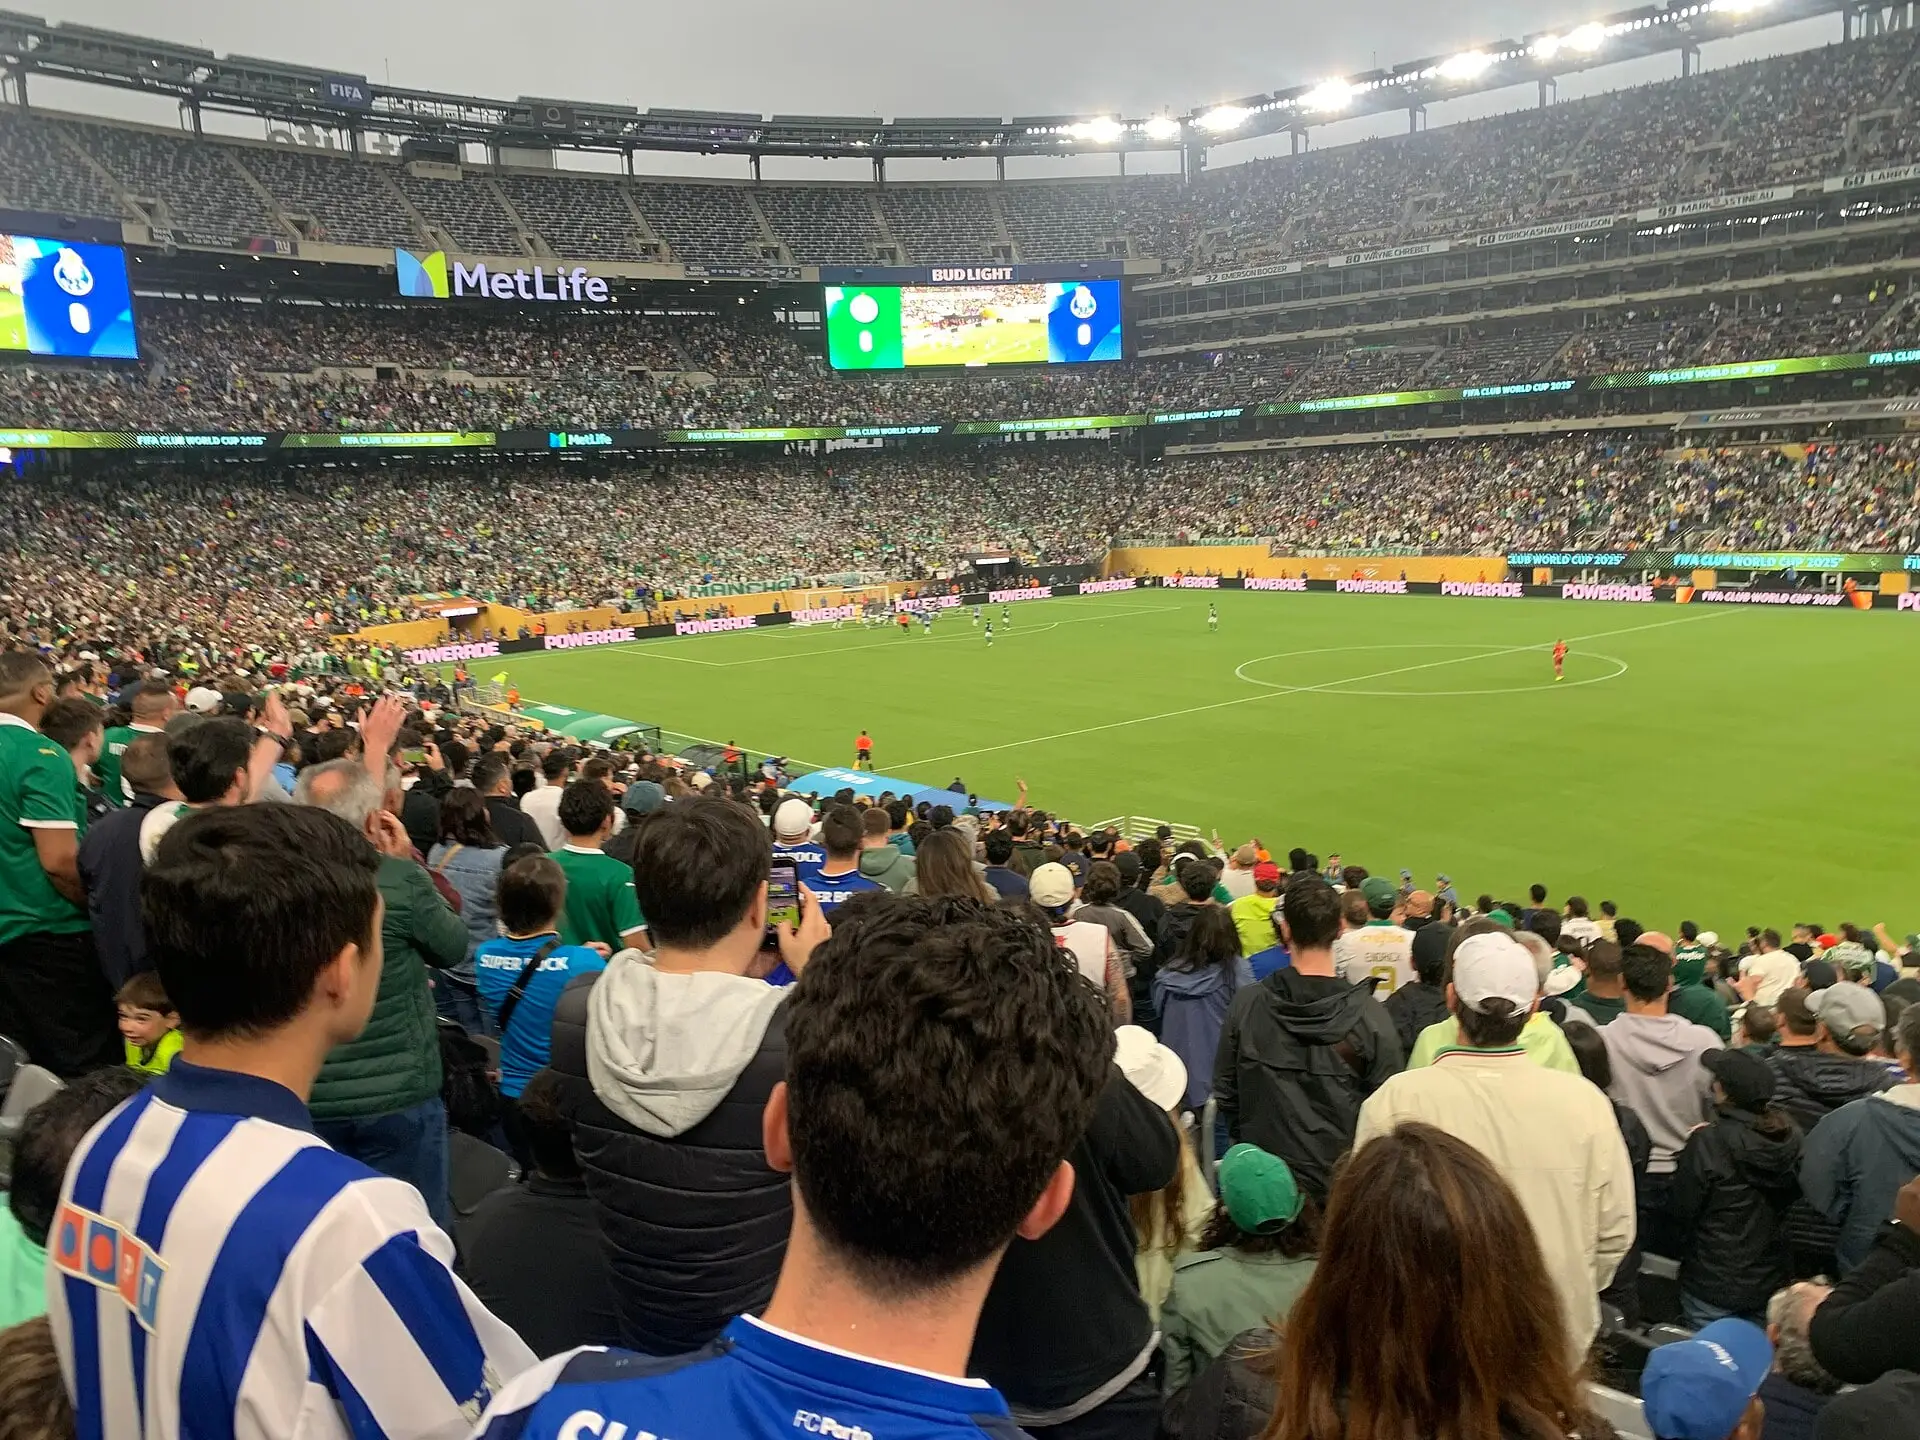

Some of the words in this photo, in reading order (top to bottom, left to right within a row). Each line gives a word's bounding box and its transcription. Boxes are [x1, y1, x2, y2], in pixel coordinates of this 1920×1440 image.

[330, 83, 362, 100] FIFA
[1479, 234, 1496, 246] 60
[1563, 217, 1611, 233] FERGUSON
[1345, 254, 1361, 265] 80
[1363, 250, 1393, 262] WAYNE
[1393, 244, 1431, 258] CHREBET
[453, 261, 609, 303] MetLife
[932, 268, 966, 282] BUD
[967, 267, 1013, 281] LIGHT
[1204, 274, 1218, 284] 32
[1220, 267, 1257, 281] EMERSON
[1256, 264, 1287, 276] BOOZER
[1870, 352, 1894, 365] FIFA
[1649, 372, 1669, 384] FIFA
[1669, 369, 1694, 381] CLUB
[1695, 366, 1730, 379] WORLD
[1730, 364, 1751, 376] CUP
[1462, 388, 1481, 398] FIFA
[1481, 386, 1501, 397] CLUB
[1501, 384, 1532, 395] WORLD
[1532, 382, 1550, 393] CUP
[1154, 414, 1169, 423] FIFA
[1169, 413, 1186, 422] CLUB
[1186, 411, 1210, 421] WORLD
[1210, 410, 1223, 419] CUP
[845, 427, 862, 437] FIFA
[861, 427, 880, 437] CLUB
[880, 427, 906, 436] WORLD
[906, 426, 921, 435] CUP
[136, 435, 160, 446] FIFA
[159, 436, 186, 446] CLUB
[186, 436, 221, 446] WORLD
[221, 437, 241, 446] CUP
[567, 434, 613, 446] MetLife
[1532, 554, 1571, 565] WORLD
[1571, 554, 1594, 565] CUP
[1674, 554, 1697, 566] FIFA
[1697, 555, 1732, 567] CLUB
[1732, 555, 1780, 568] WORLD
[1779, 556, 1805, 568] CUP
[1079, 577, 1137, 595] POWERADE
[1244, 577, 1306, 592] POWERADE
[1336, 579, 1407, 594] POWERADE
[1441, 582, 1522, 598] POWERADE
[1562, 583, 1655, 602] POWERADE
[989, 586, 1052, 603] POWERADE
[1702, 591, 1723, 602] FIFA
[1722, 592, 1751, 604] CLUB
[1750, 592, 1789, 605] WORLD
[1788, 593, 1812, 606] CUP
[675, 615, 757, 636] POWERADE
[544, 626, 637, 649] POWERADE
[480, 954, 523, 971] SUPER
[793, 1409, 821, 1433] FC
